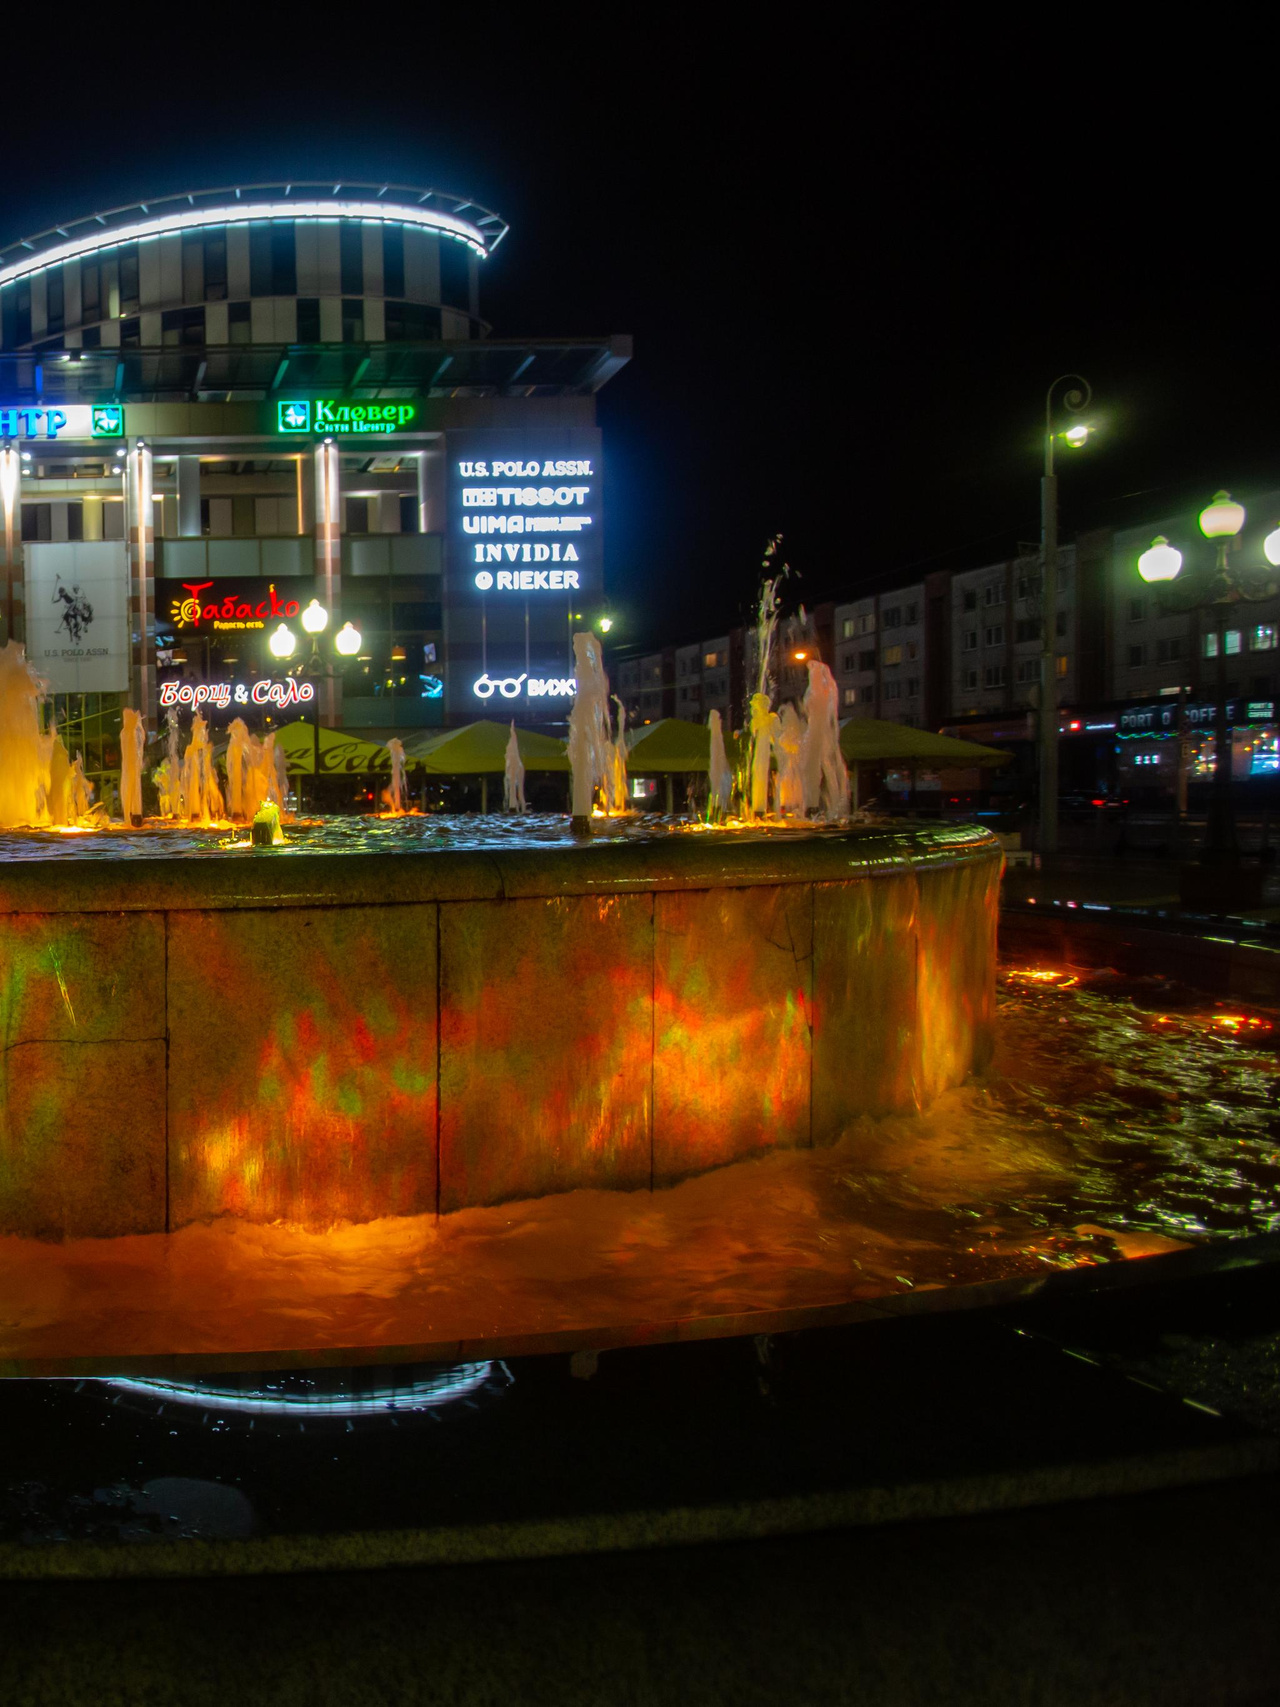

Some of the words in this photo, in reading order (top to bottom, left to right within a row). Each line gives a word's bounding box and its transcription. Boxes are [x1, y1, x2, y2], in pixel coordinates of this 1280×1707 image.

[315, 400, 415, 424] Кловер
[314, 421, 350, 433] Сити
[352, 421, 396, 434] Центр
[459, 462, 490, 477] U.S.
[492, 461, 540, 477] POLO
[542, 460, 594, 476] ASSN.
[496, 486, 590, 506] TISSOT
[474, 543, 580, 563] INVIDIA
[496, 570, 580, 590] RIEKER
[160, 680, 232, 712] Борщ
[234, 684, 249, 703] &
[251, 677, 314, 709] Сало
[1121, 713, 1154, 728] PORT
